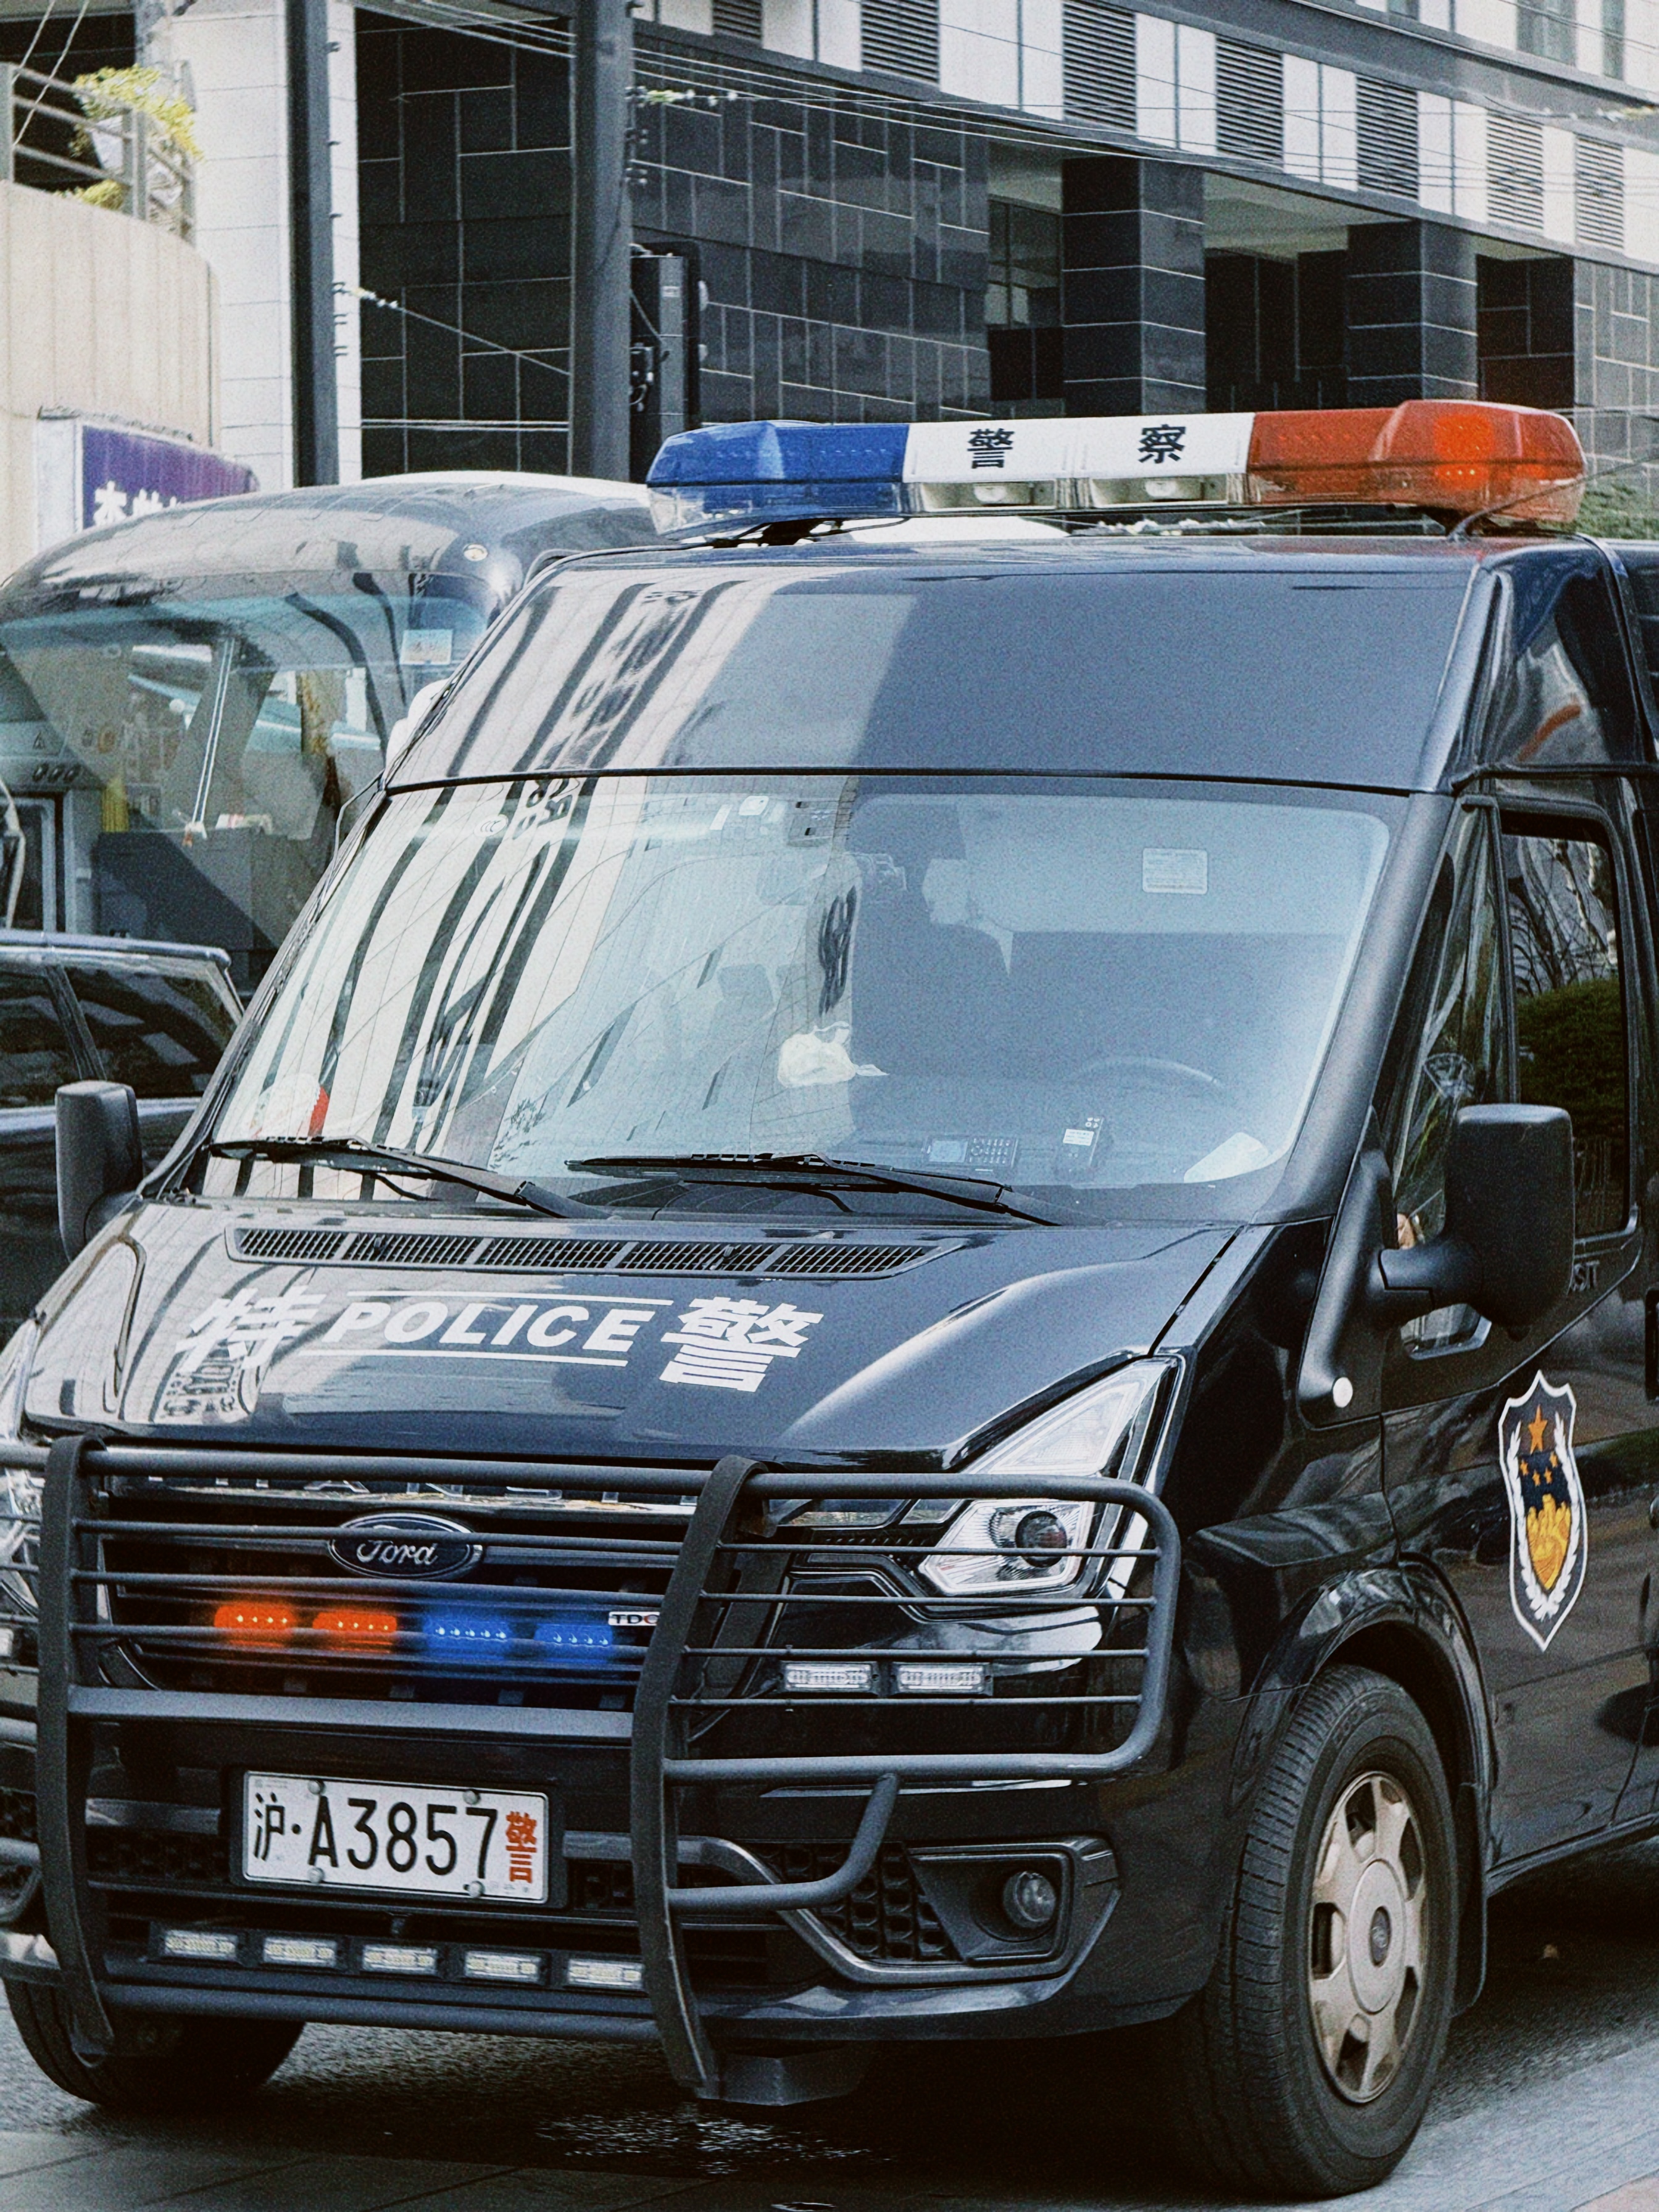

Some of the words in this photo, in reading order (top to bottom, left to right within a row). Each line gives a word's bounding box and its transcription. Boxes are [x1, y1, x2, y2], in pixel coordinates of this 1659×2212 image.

[967, 424, 1186, 469] 警察
[175, 1285, 326, 1371] 特
[322, 1302, 655, 1352] POLICE
[659, 1297, 824, 1392] 警
[356, 1524, 438, 1565] Ford
